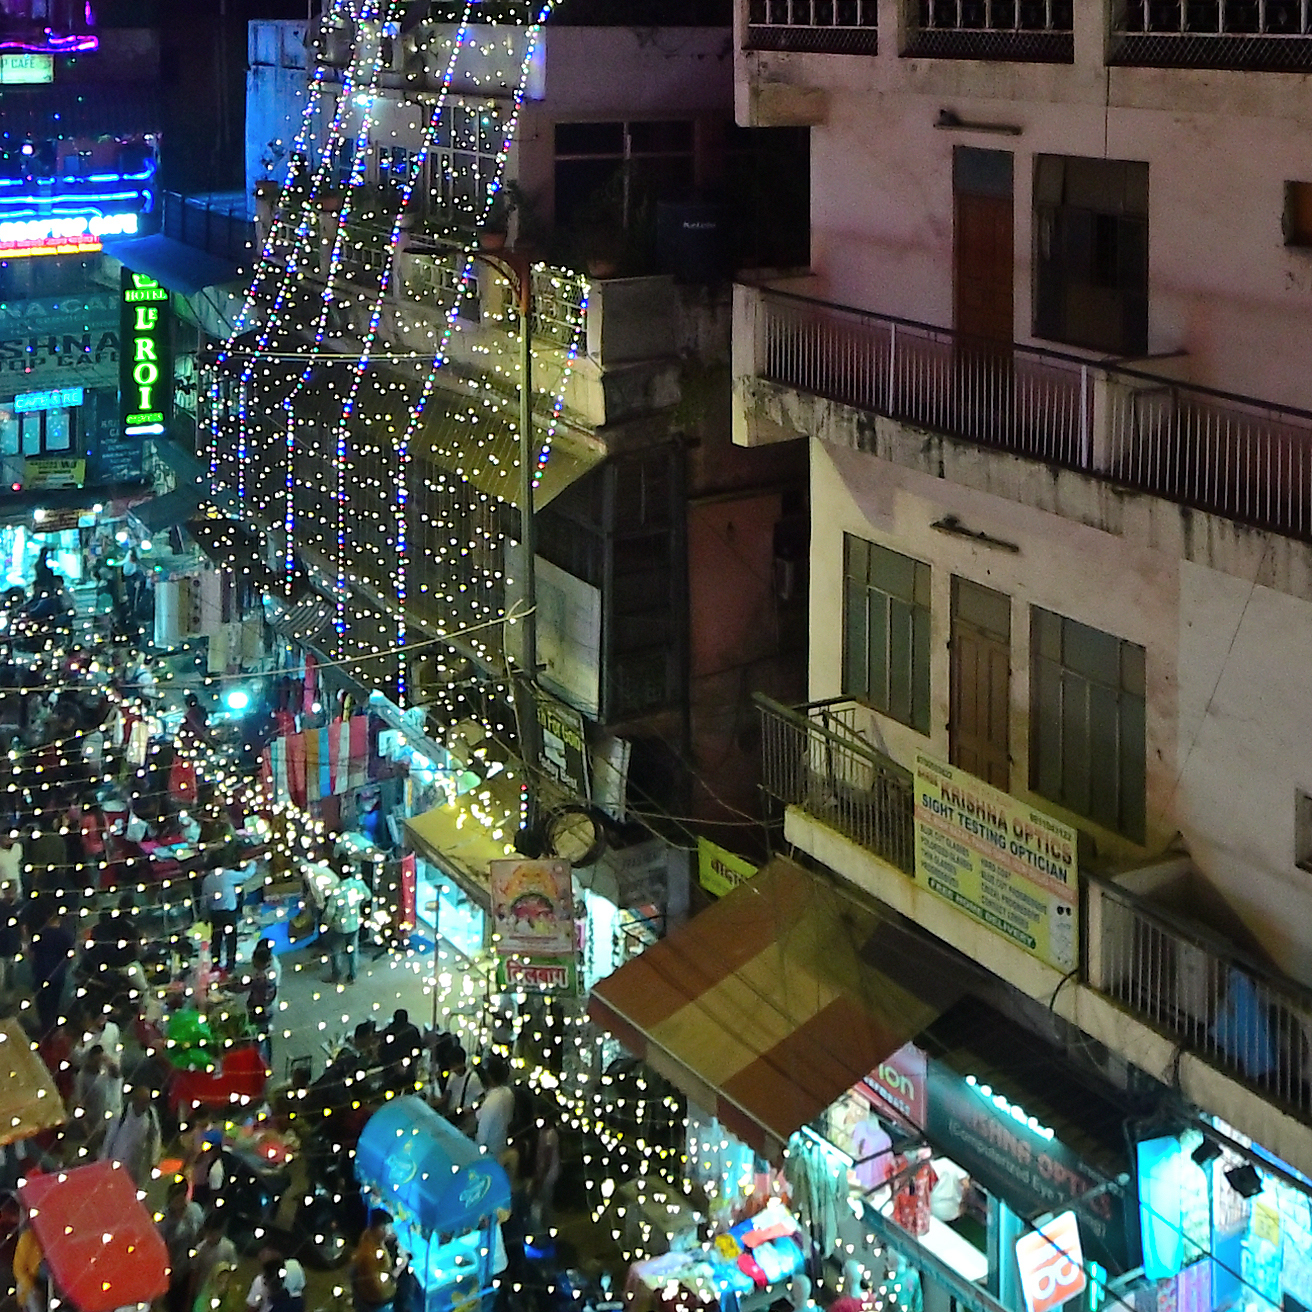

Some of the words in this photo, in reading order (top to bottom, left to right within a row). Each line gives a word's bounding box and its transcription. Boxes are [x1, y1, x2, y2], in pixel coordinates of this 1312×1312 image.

[11, 59, 35, 69] CAFE
[60, 295, 120, 315] CAF
[126, 289, 168, 302] HOTEL
[57, 351, 121, 368] CAFE
[133, 337, 158, 410] ROI
[941, 779, 1008, 835] KRISHNA
[1012, 816, 1073, 866] OPTICS
[922, 793, 954, 822] SIGHT
[958, 811, 1006, 849] TESTING
[1010, 840, 1068, 884] OPTICIAN
